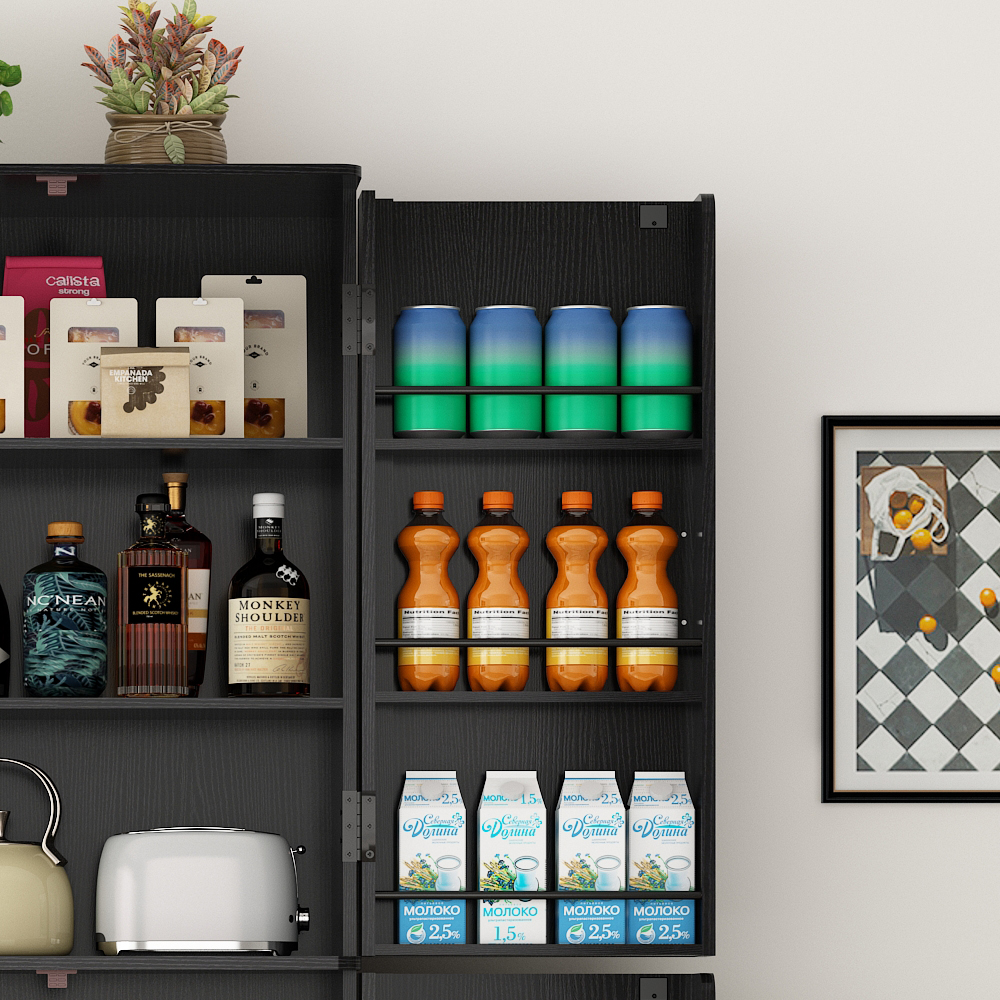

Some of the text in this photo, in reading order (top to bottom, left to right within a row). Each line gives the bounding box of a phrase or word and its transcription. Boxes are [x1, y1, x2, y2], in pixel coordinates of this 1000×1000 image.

[46, 276, 100, 287] Calista
[58, 288, 90, 296] strong
[240, 600, 300, 610] MONKEY
[235, 613, 304, 622] SHOULDER
[403, 818, 458, 839] Долина
[482, 818, 536, 840] Долина
[562, 818, 618, 839] Долина
[632, 818, 688, 840] Долина
[404, 906, 460, 916] МОЛОКО
[483, 907, 538, 916] МОЛОКО
[564, 906, 620, 916] МОЛОКО
[634, 906, 690, 916] МОЛОКО
[429, 924, 460, 942] 2,5%
[494, 926, 526, 942] 1,5%
[589, 924, 620, 941] 2,5%
[659, 924, 690, 942] 2,5%
